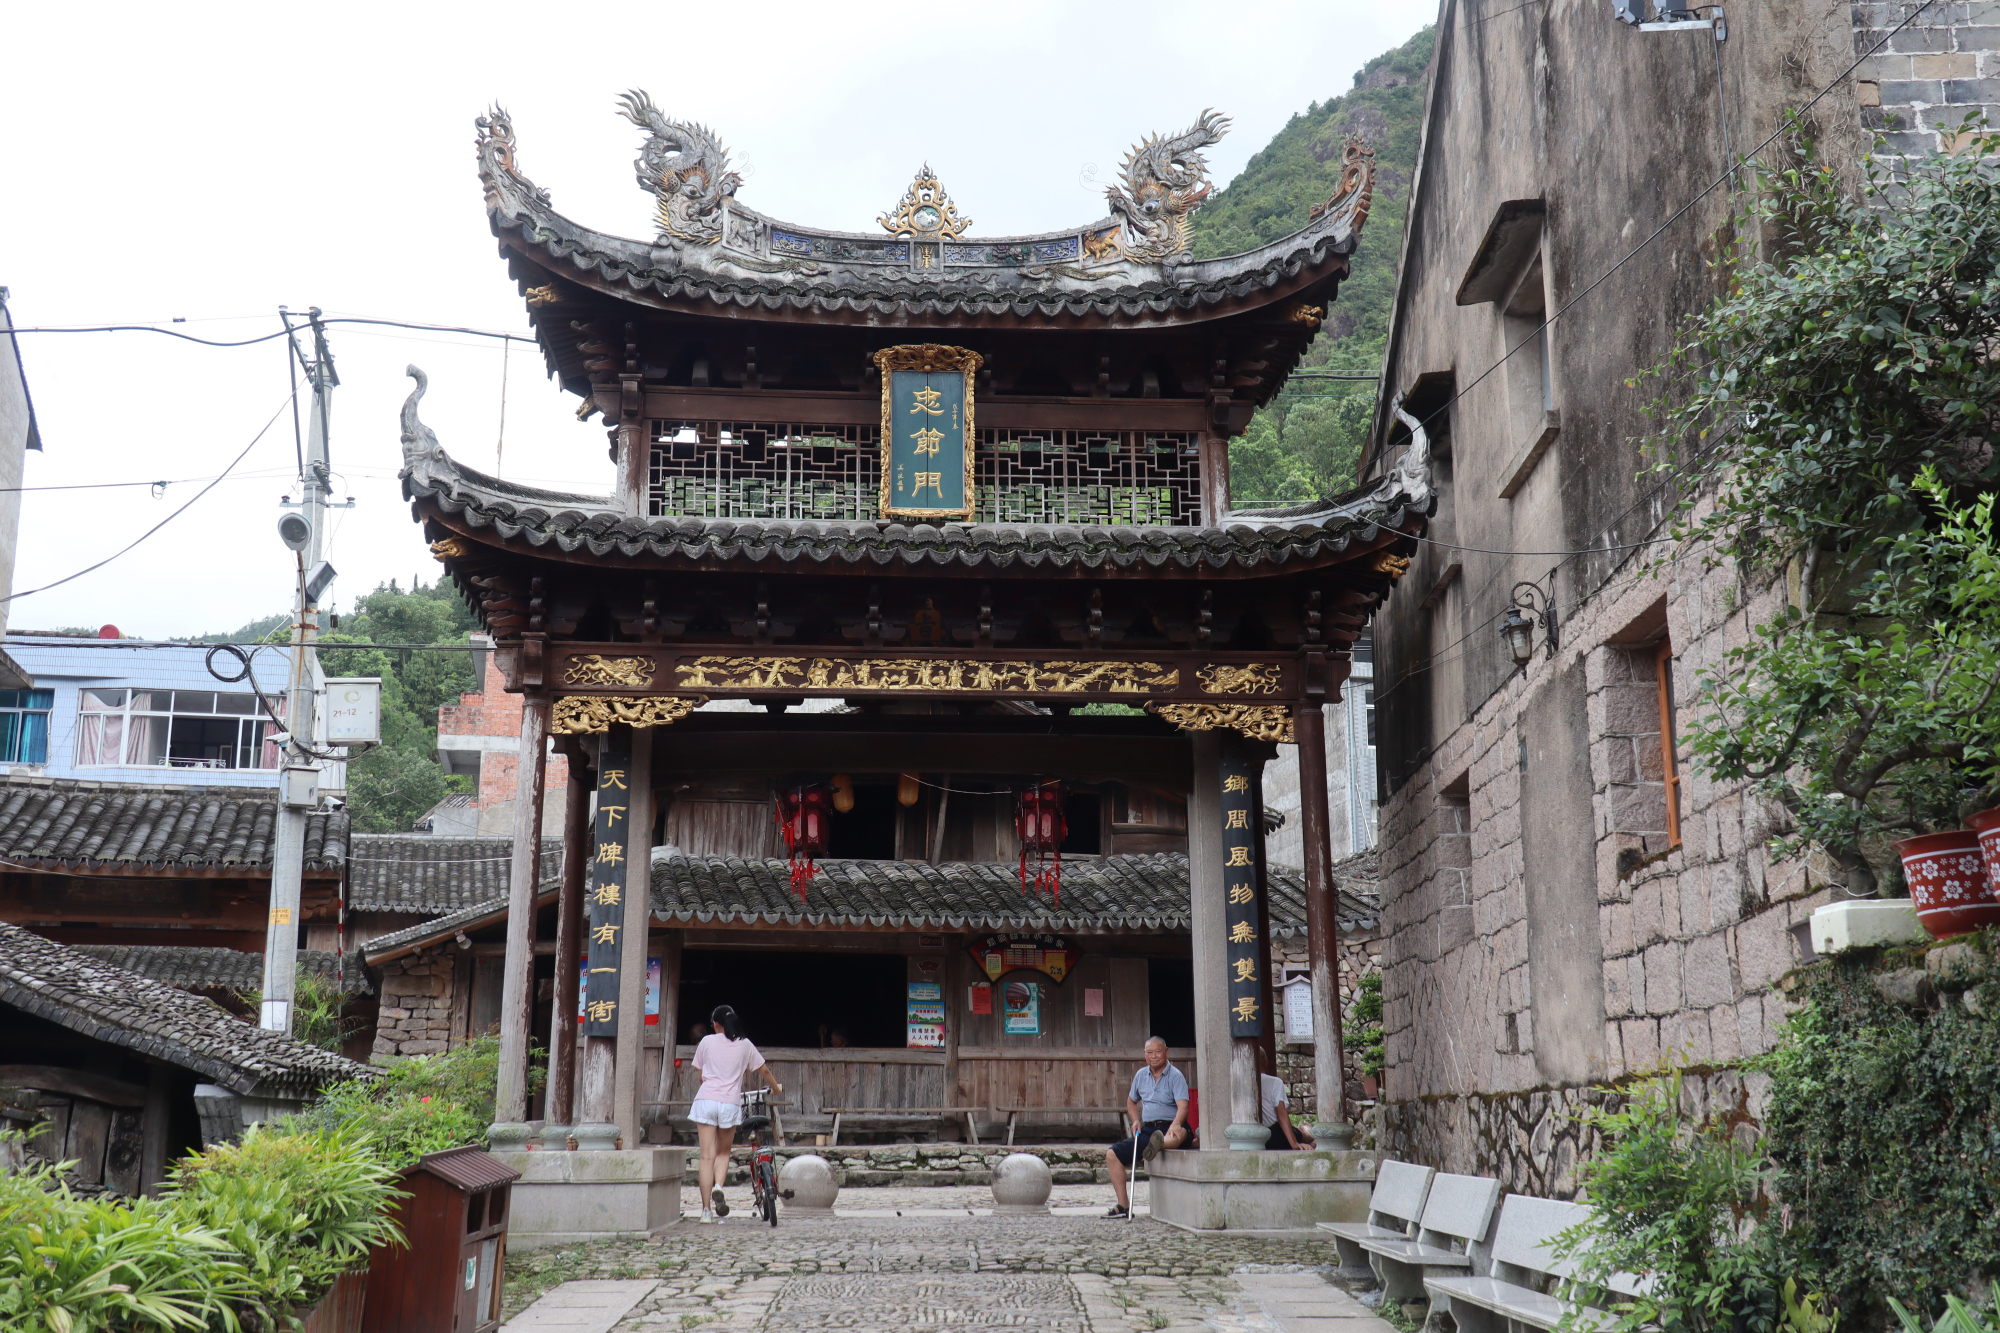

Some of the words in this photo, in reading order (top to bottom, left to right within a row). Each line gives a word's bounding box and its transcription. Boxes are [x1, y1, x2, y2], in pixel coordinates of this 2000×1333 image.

[909, 385, 946, 499] 忠節門
[333, 708, 357, 718] 21-12
[587, 769, 628, 1023] 天下牌樓有一街
